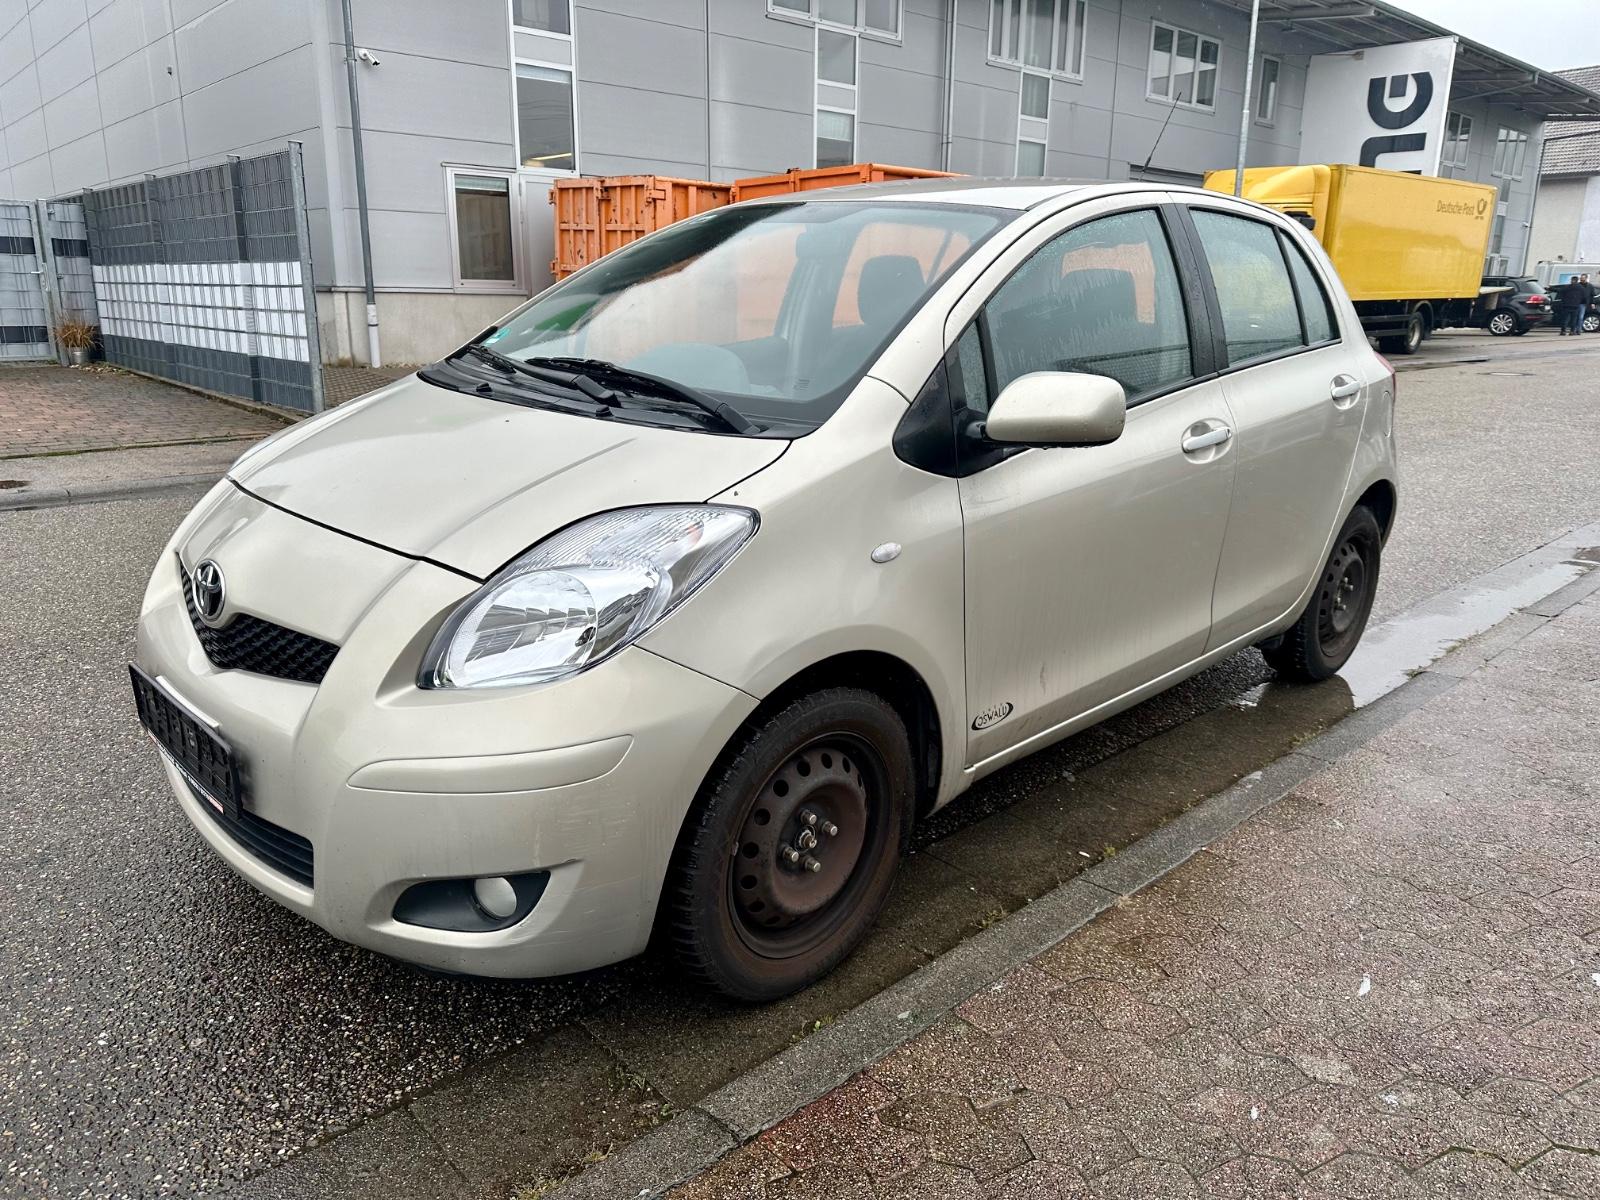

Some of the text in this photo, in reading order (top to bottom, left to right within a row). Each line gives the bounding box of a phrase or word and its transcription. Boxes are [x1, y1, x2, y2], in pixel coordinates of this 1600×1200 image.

[1436, 199, 1475, 216] Deutsche Post
[977, 705, 1007, 727] OSWALD
